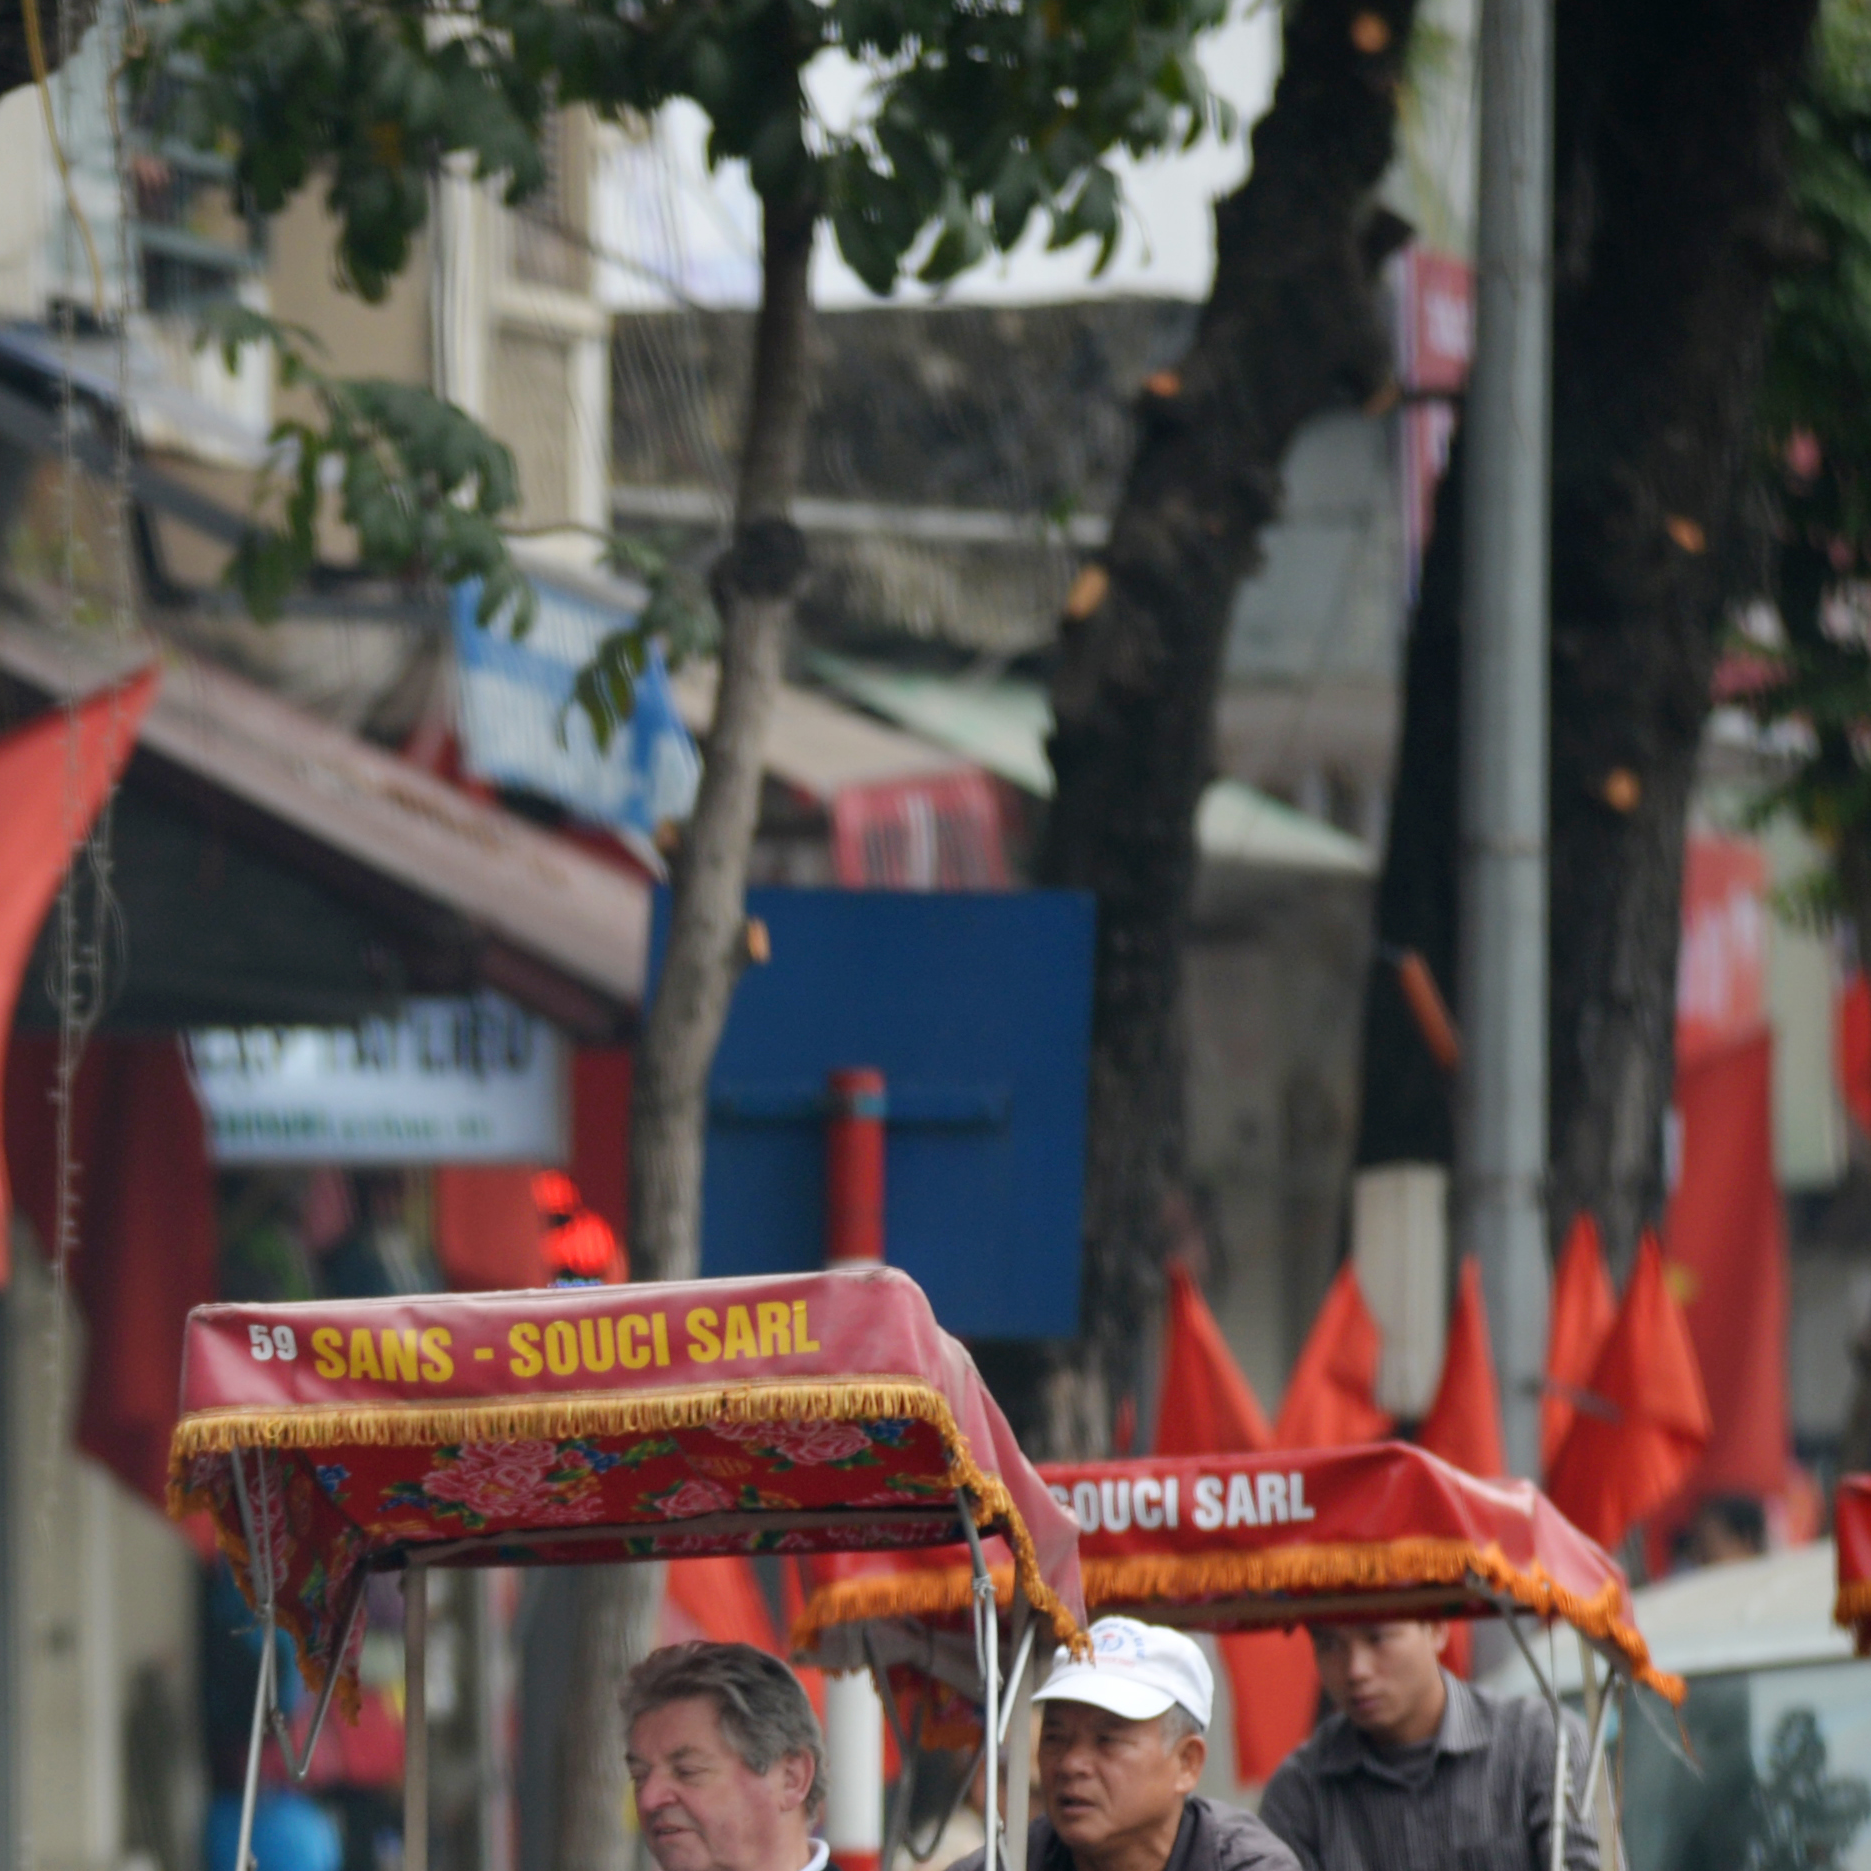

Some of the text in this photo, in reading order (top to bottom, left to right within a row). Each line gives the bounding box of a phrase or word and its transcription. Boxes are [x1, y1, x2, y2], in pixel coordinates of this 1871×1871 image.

[248, 1323, 298, 1362] 59
[311, 1325, 455, 1384] SANS
[507, 1311, 671, 1378] SOUCI
[686, 1299, 820, 1364] SARL
[1193, 1470, 1317, 1531] SARL
